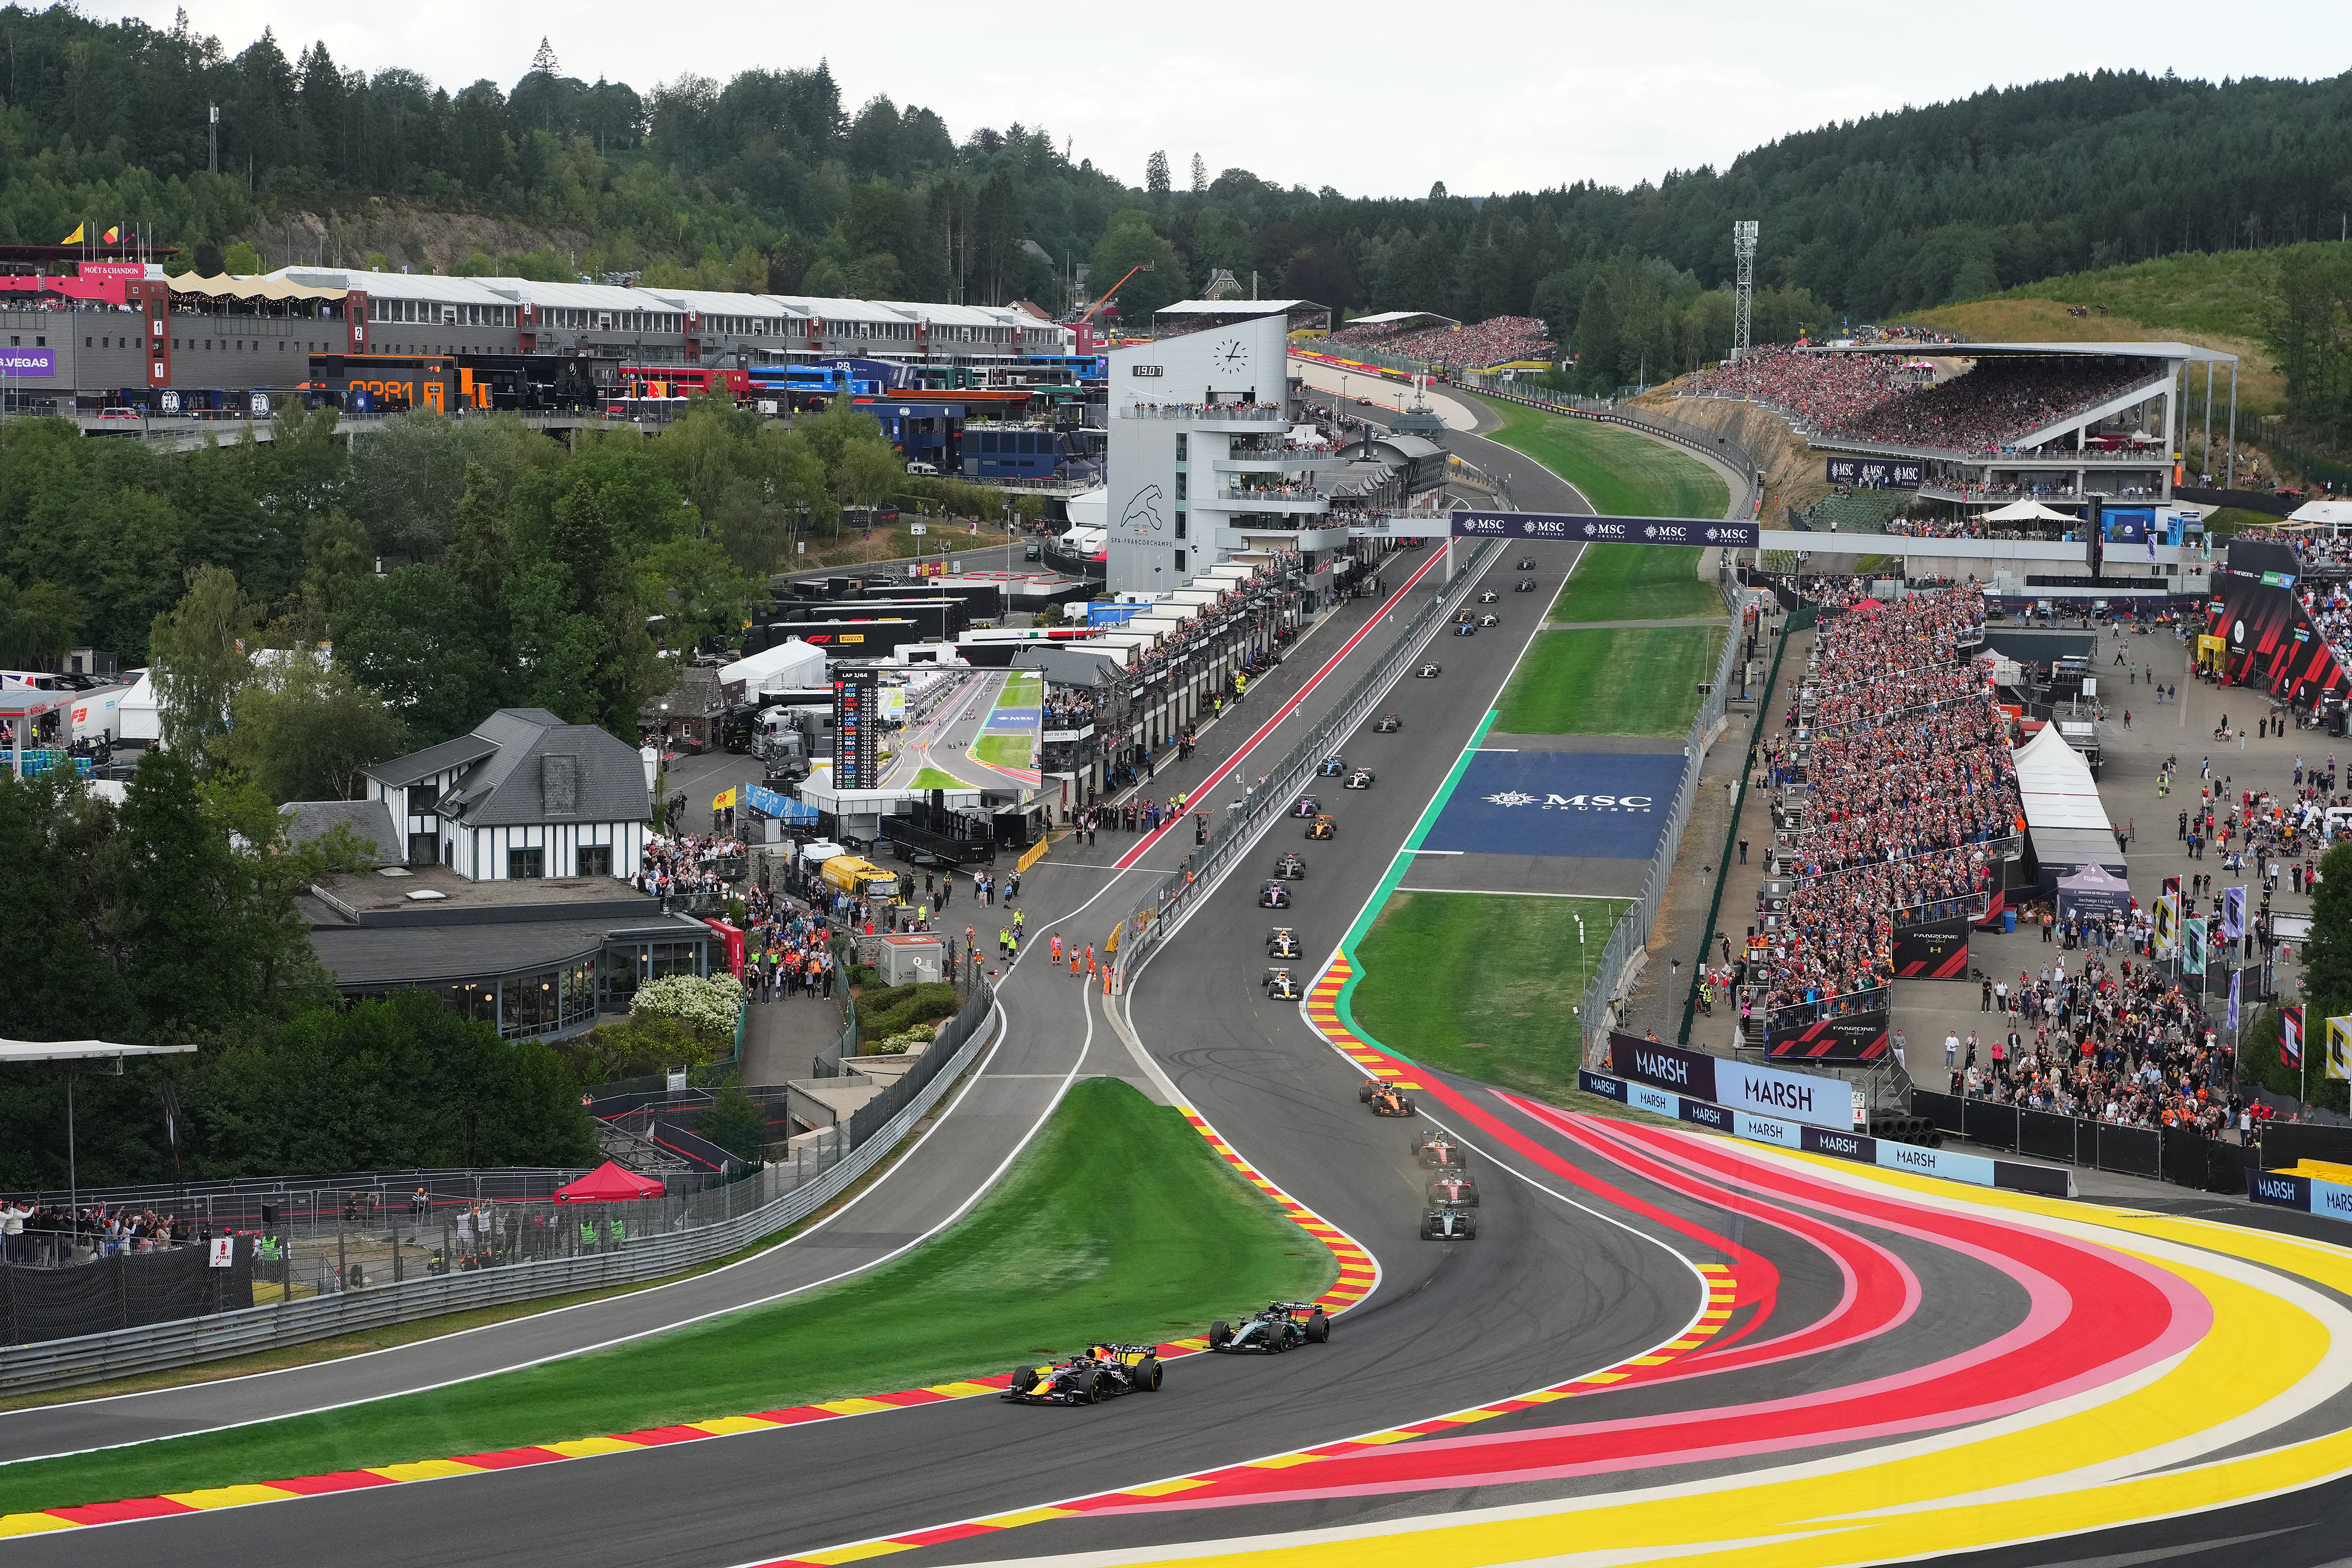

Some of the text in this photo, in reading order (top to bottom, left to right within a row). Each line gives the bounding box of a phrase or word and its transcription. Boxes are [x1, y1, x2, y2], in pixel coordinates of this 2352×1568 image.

[525, 303, 530, 313] 3
[690, 311, 694, 321] 4
[814, 316, 818, 326] 5
[156, 323, 160, 334] 1
[922, 321, 926, 330] 6
[1017, 324, 1020, 333] 7
[356, 328, 360, 339] 2
[157, 365, 161, 376] 1
[1137, 366, 1162, 376] 19.07
[1839, 463, 1854, 476] MSC
[1870, 465, 1885, 477] MSC
[1902, 467, 1918, 481] MSC
[1478, 519, 1504, 530] MSC
[1538, 522, 1564, 532] MSC
[1598, 525, 1625, 535] MSC
[1659, 527, 1686, 537] MSC
[1720, 529, 1747, 539] MSC
[1111, 538, 1172, 547] SPA-FRANCORCHAMPS
[1544, 794, 1652, 807] MSC
[826, 872, 839, 883] METRAS
[711, 928, 719, 937] HANK
[1635, 1049, 1687, 1085] MARSH
[1591, 1077, 1615, 1095] MARSH
[1745, 1075, 1812, 1112] MARSH
[1641, 1092, 1666, 1109] MARSH
[1693, 1105, 1720, 1124] MARSH
[1749, 1120, 1782, 1139] MARSH
[1820, 1135, 1857, 1154] MARSH
[1897, 1149, 1936, 1168] MARSH
[2259, 1178, 2295, 1201] MARSH
